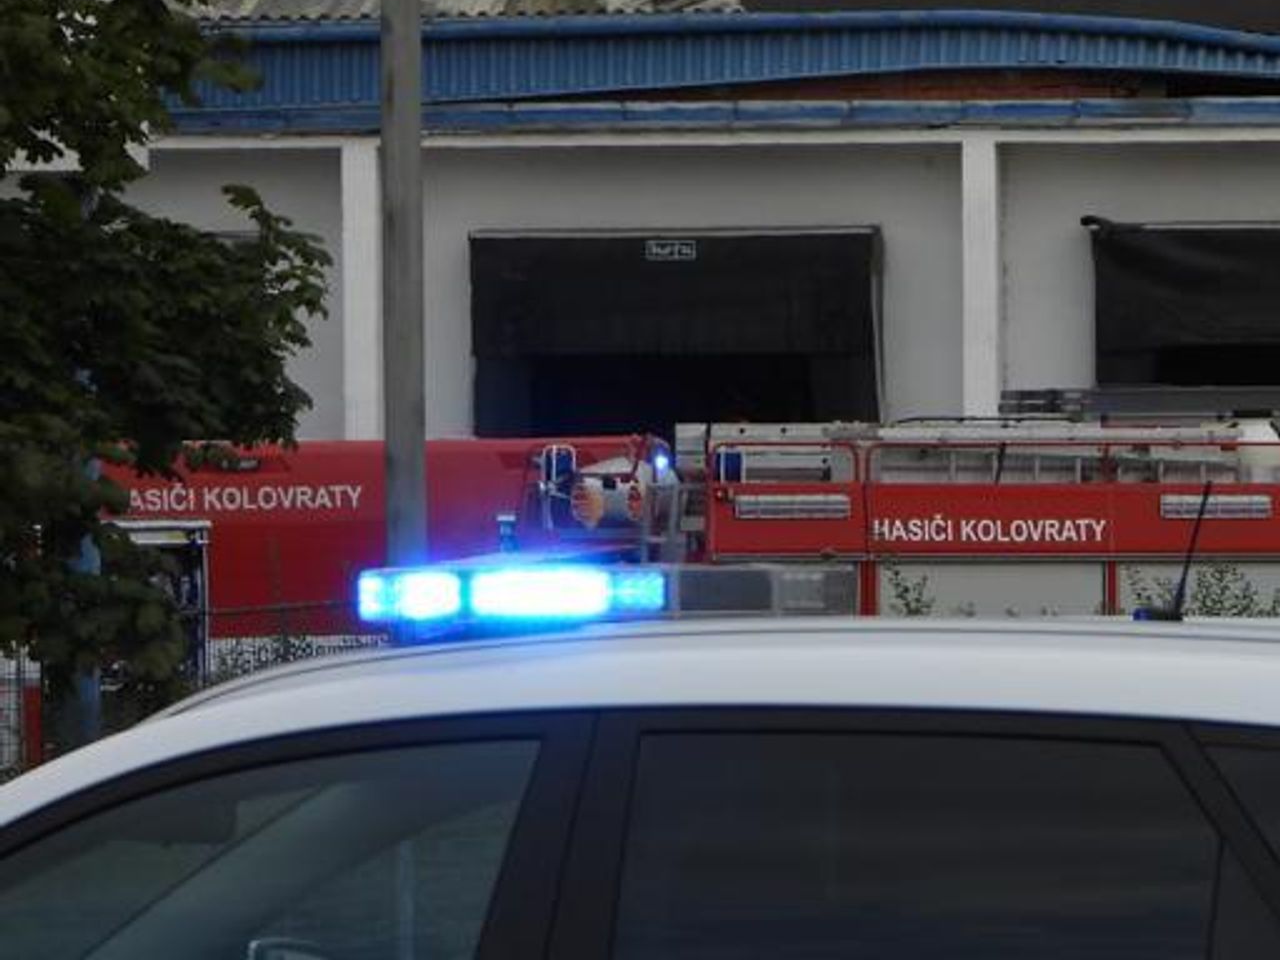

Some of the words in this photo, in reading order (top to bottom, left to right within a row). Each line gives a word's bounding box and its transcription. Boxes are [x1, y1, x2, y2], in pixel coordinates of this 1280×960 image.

[129, 483, 195, 512] ASIČI
[203, 485, 362, 511] KOLOVRATY
[873, 513, 954, 542] HASIČI
[961, 519, 1107, 543] KOLOVRATY
